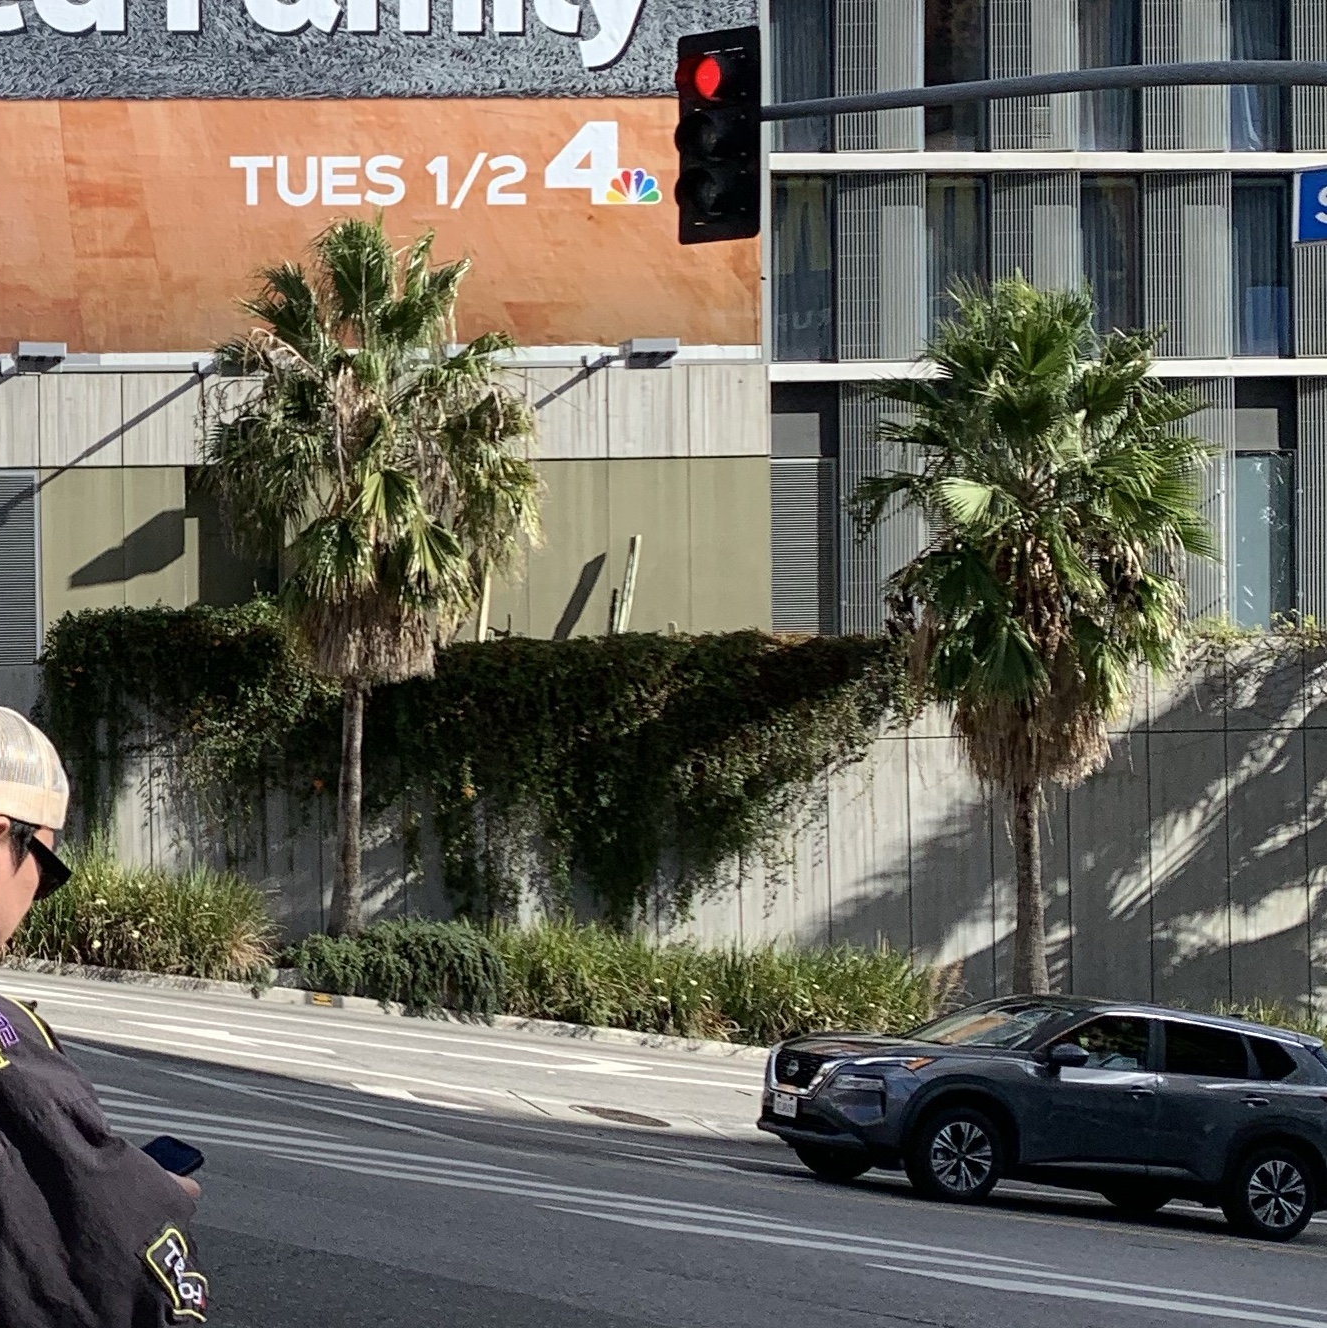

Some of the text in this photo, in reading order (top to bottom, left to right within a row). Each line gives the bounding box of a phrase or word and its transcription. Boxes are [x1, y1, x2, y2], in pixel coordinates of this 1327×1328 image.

[230, 121, 623, 208] TUES 1/2 4
